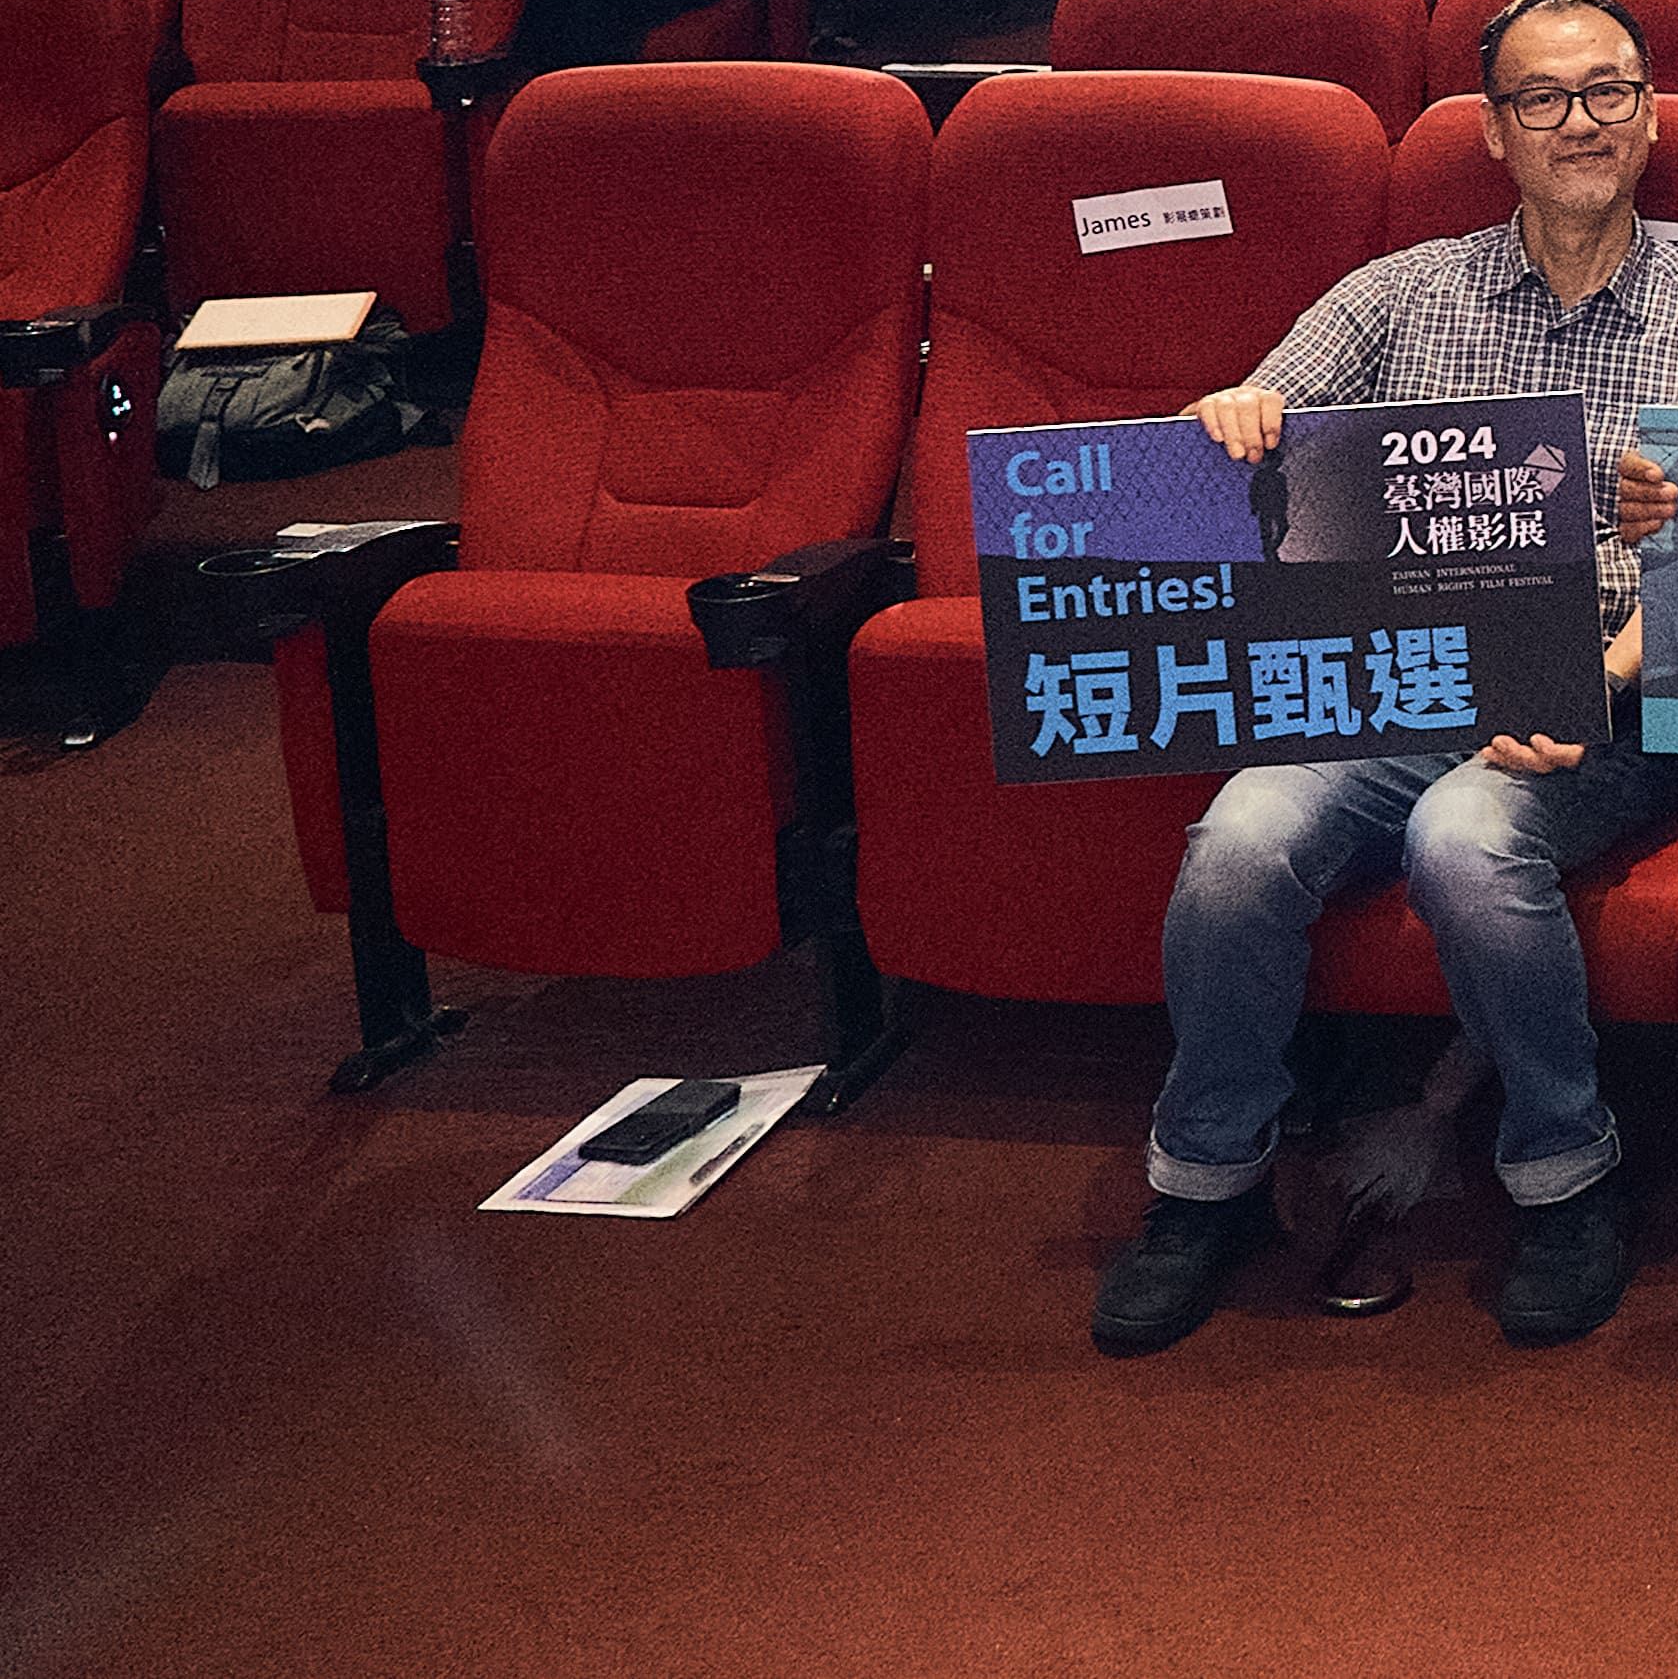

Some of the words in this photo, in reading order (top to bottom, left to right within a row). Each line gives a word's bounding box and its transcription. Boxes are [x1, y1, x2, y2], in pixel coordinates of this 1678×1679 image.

[1081, 211, 1151, 237] James
[1381, 425, 1496, 466] 2024
[1005, 443, 1112, 497] Call
[1383, 466, 1544, 514] 臺灣國際
[1010, 512, 1093, 560] for
[1387, 510, 1547, 559] 人權影展
[1016, 563, 1236, 623] Entries!
[1025, 626, 1479, 758] 短片甄選
